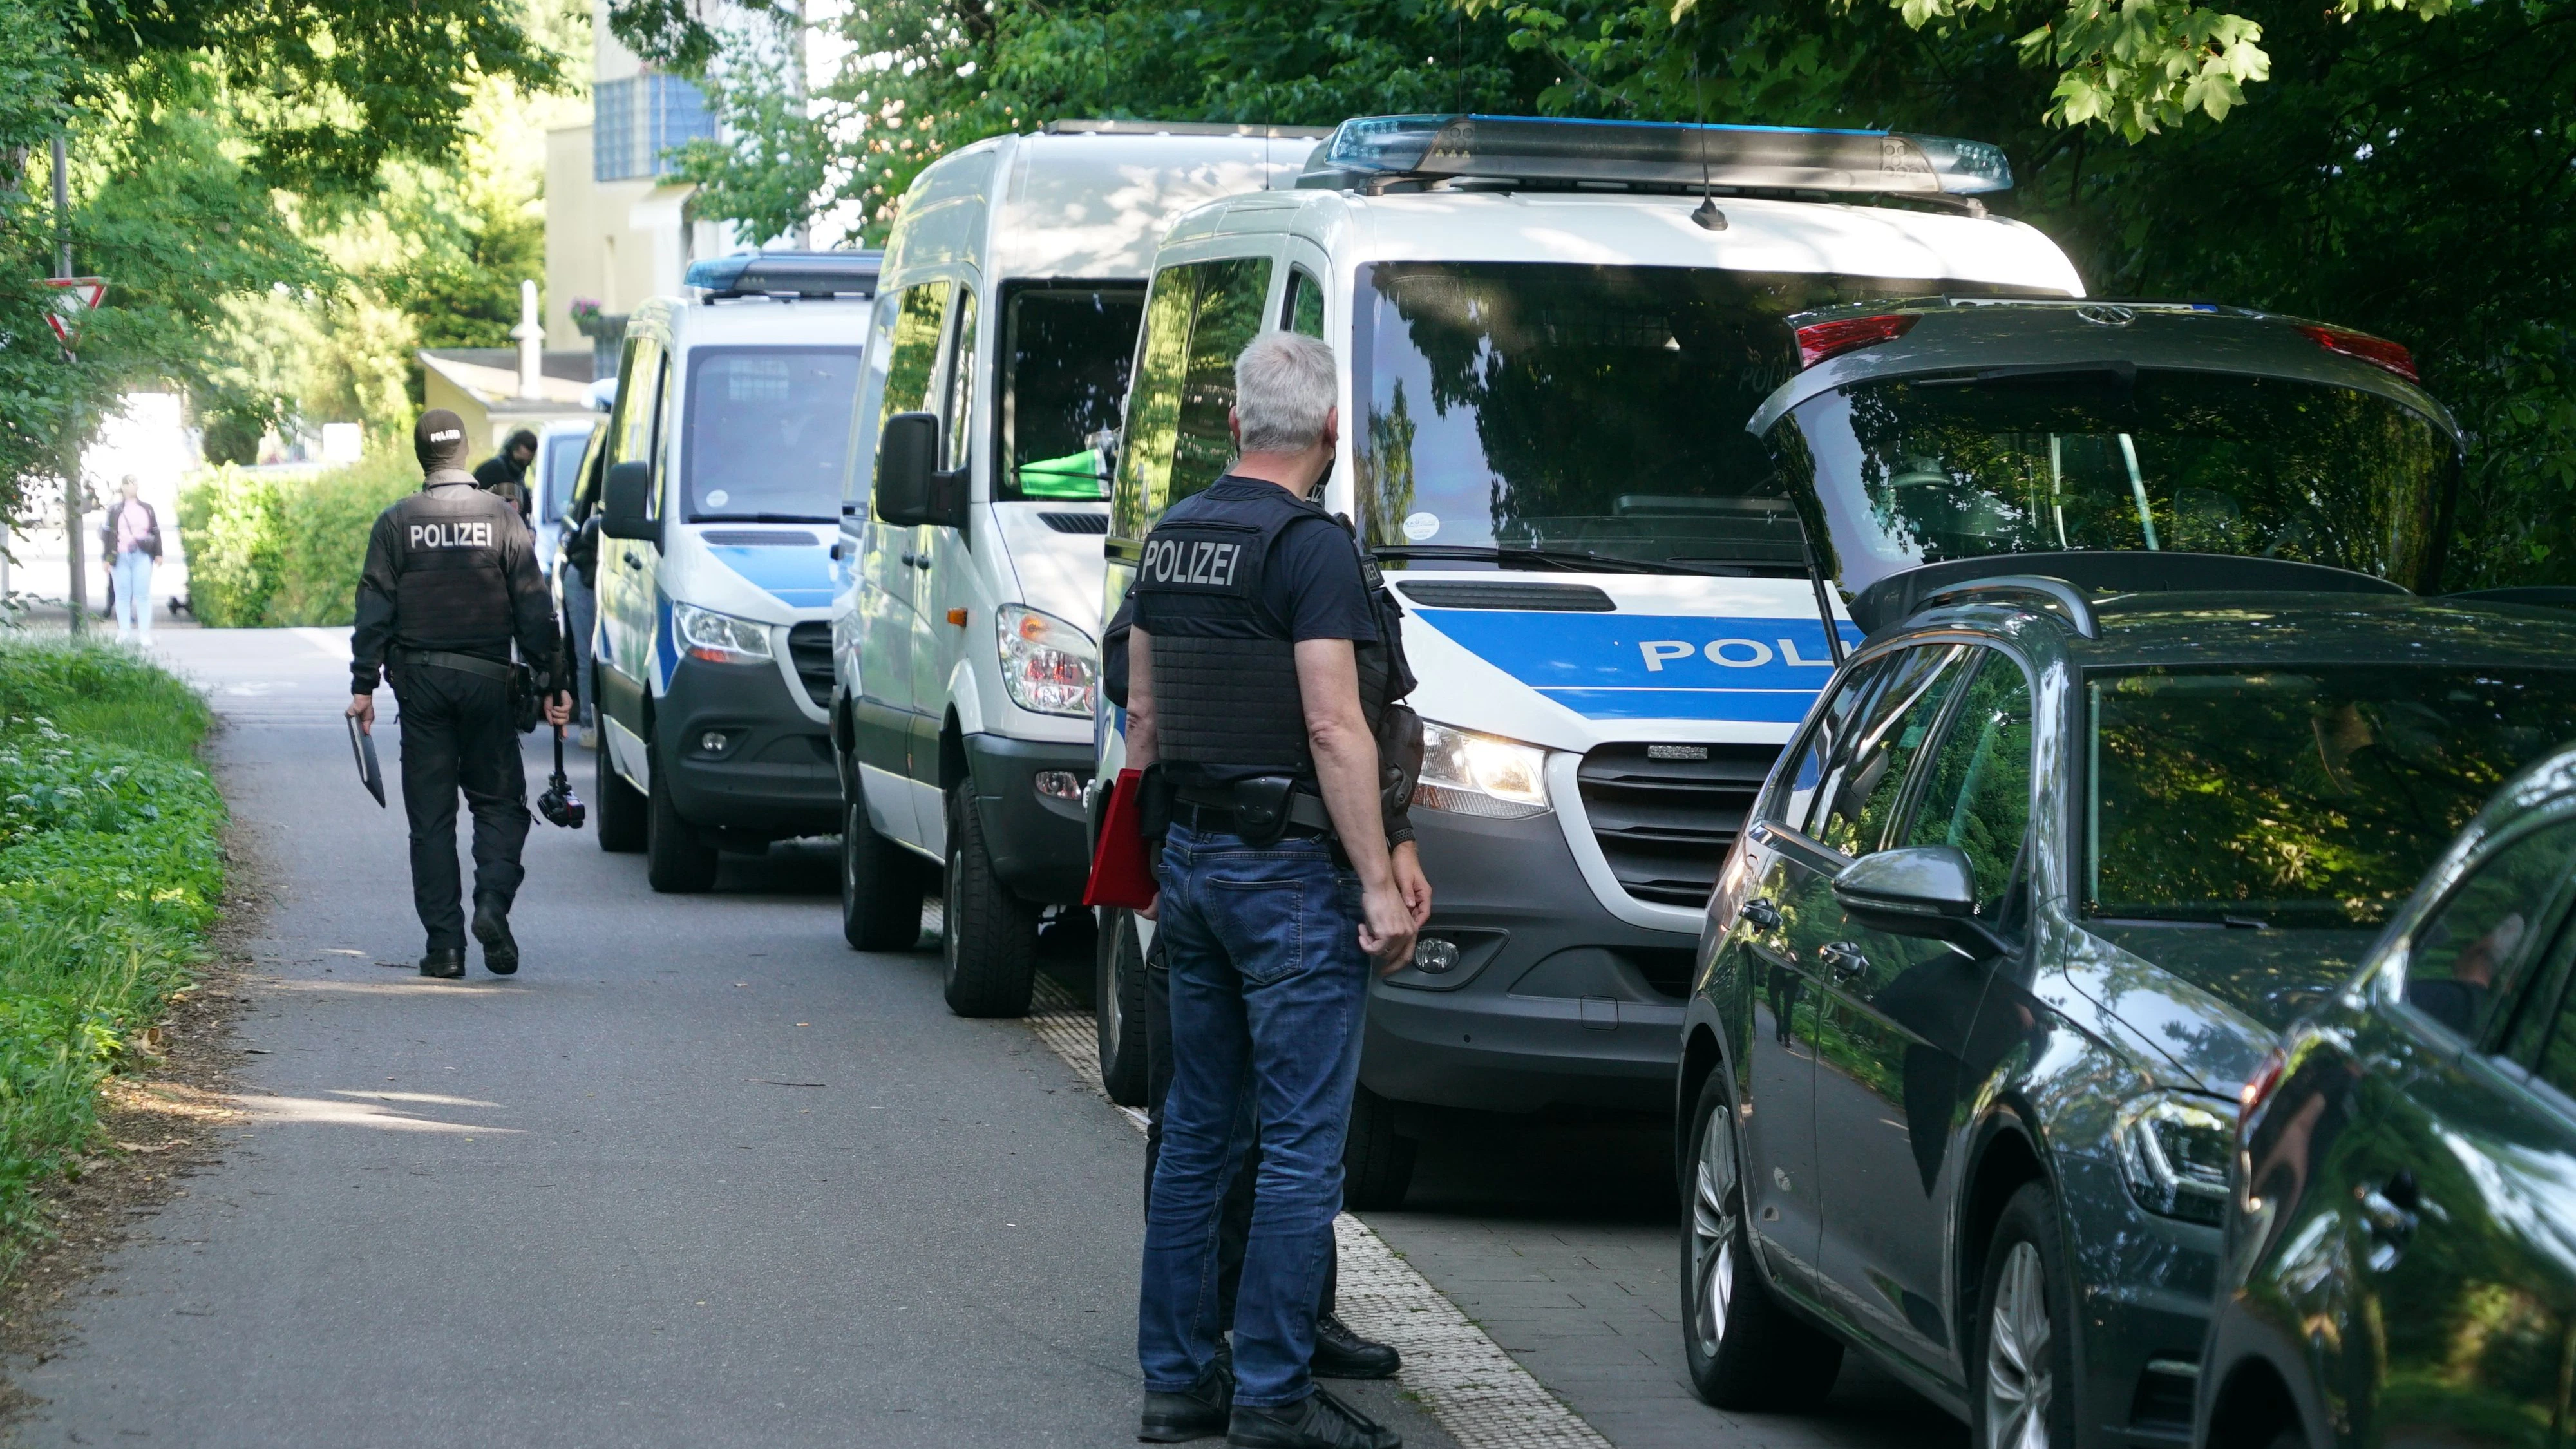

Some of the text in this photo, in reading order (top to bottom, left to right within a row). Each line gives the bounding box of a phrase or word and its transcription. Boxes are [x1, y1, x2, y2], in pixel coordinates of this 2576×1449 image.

[431, 429, 460, 443] POLIZEI
[410, 522, 492, 549] POLIZEI
[1141, 540, 1241, 586] POLIZEI
